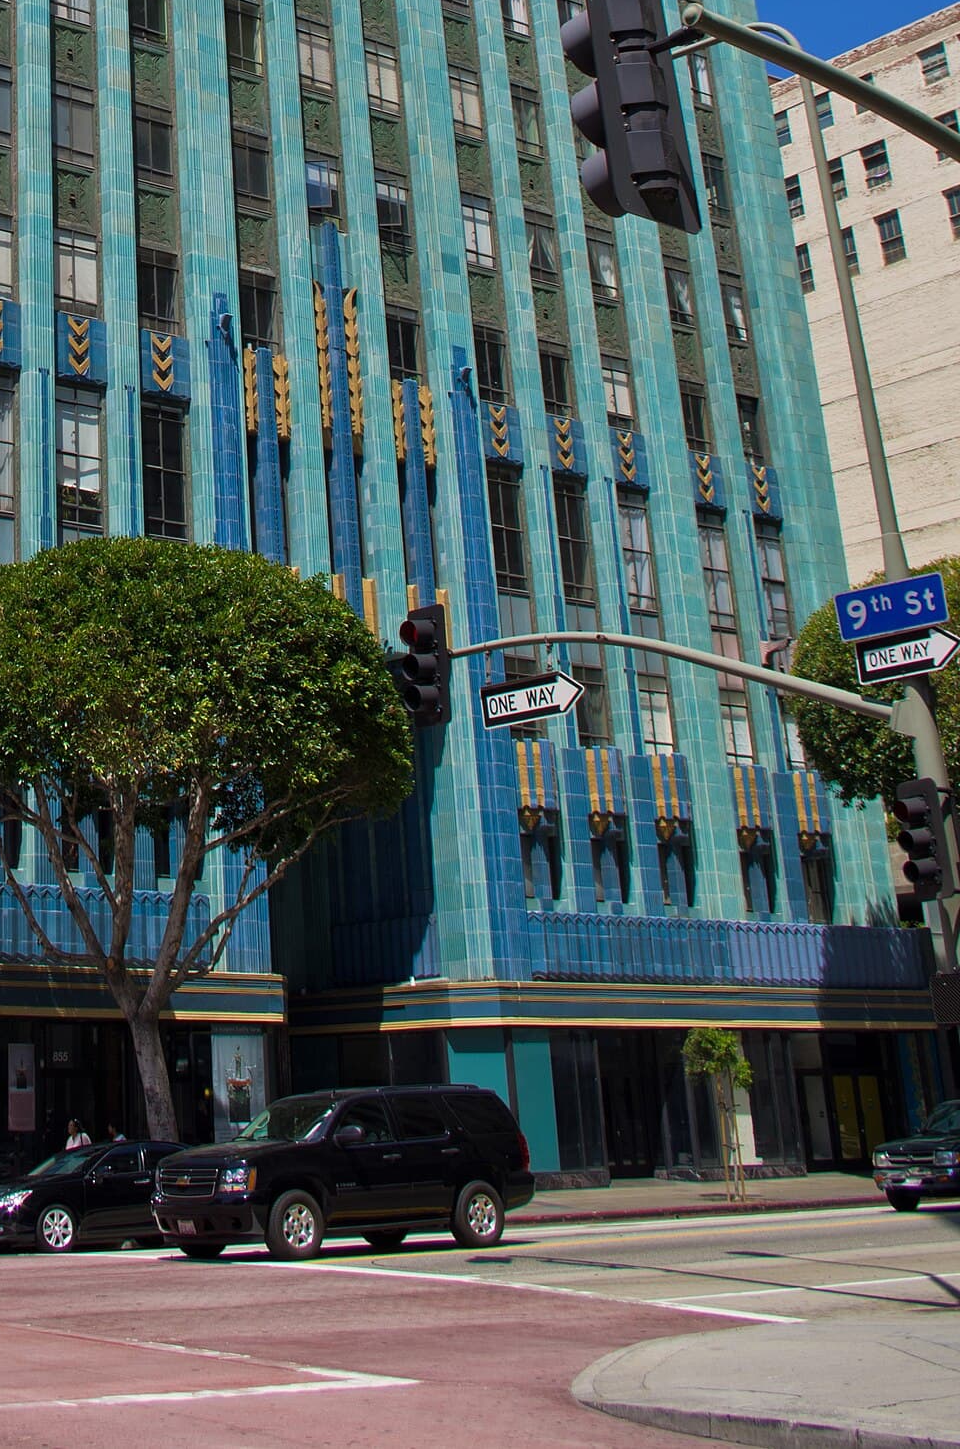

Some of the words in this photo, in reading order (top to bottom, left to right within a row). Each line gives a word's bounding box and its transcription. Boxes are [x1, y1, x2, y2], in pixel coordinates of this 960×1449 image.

[846, 594, 893, 631] 9th
[904, 588, 937, 616] St
[868, 648, 898, 668] ONE
[900, 640, 930, 662] WAY
[488, 693, 518, 716] ONE
[525, 685, 556, 709] WAY
